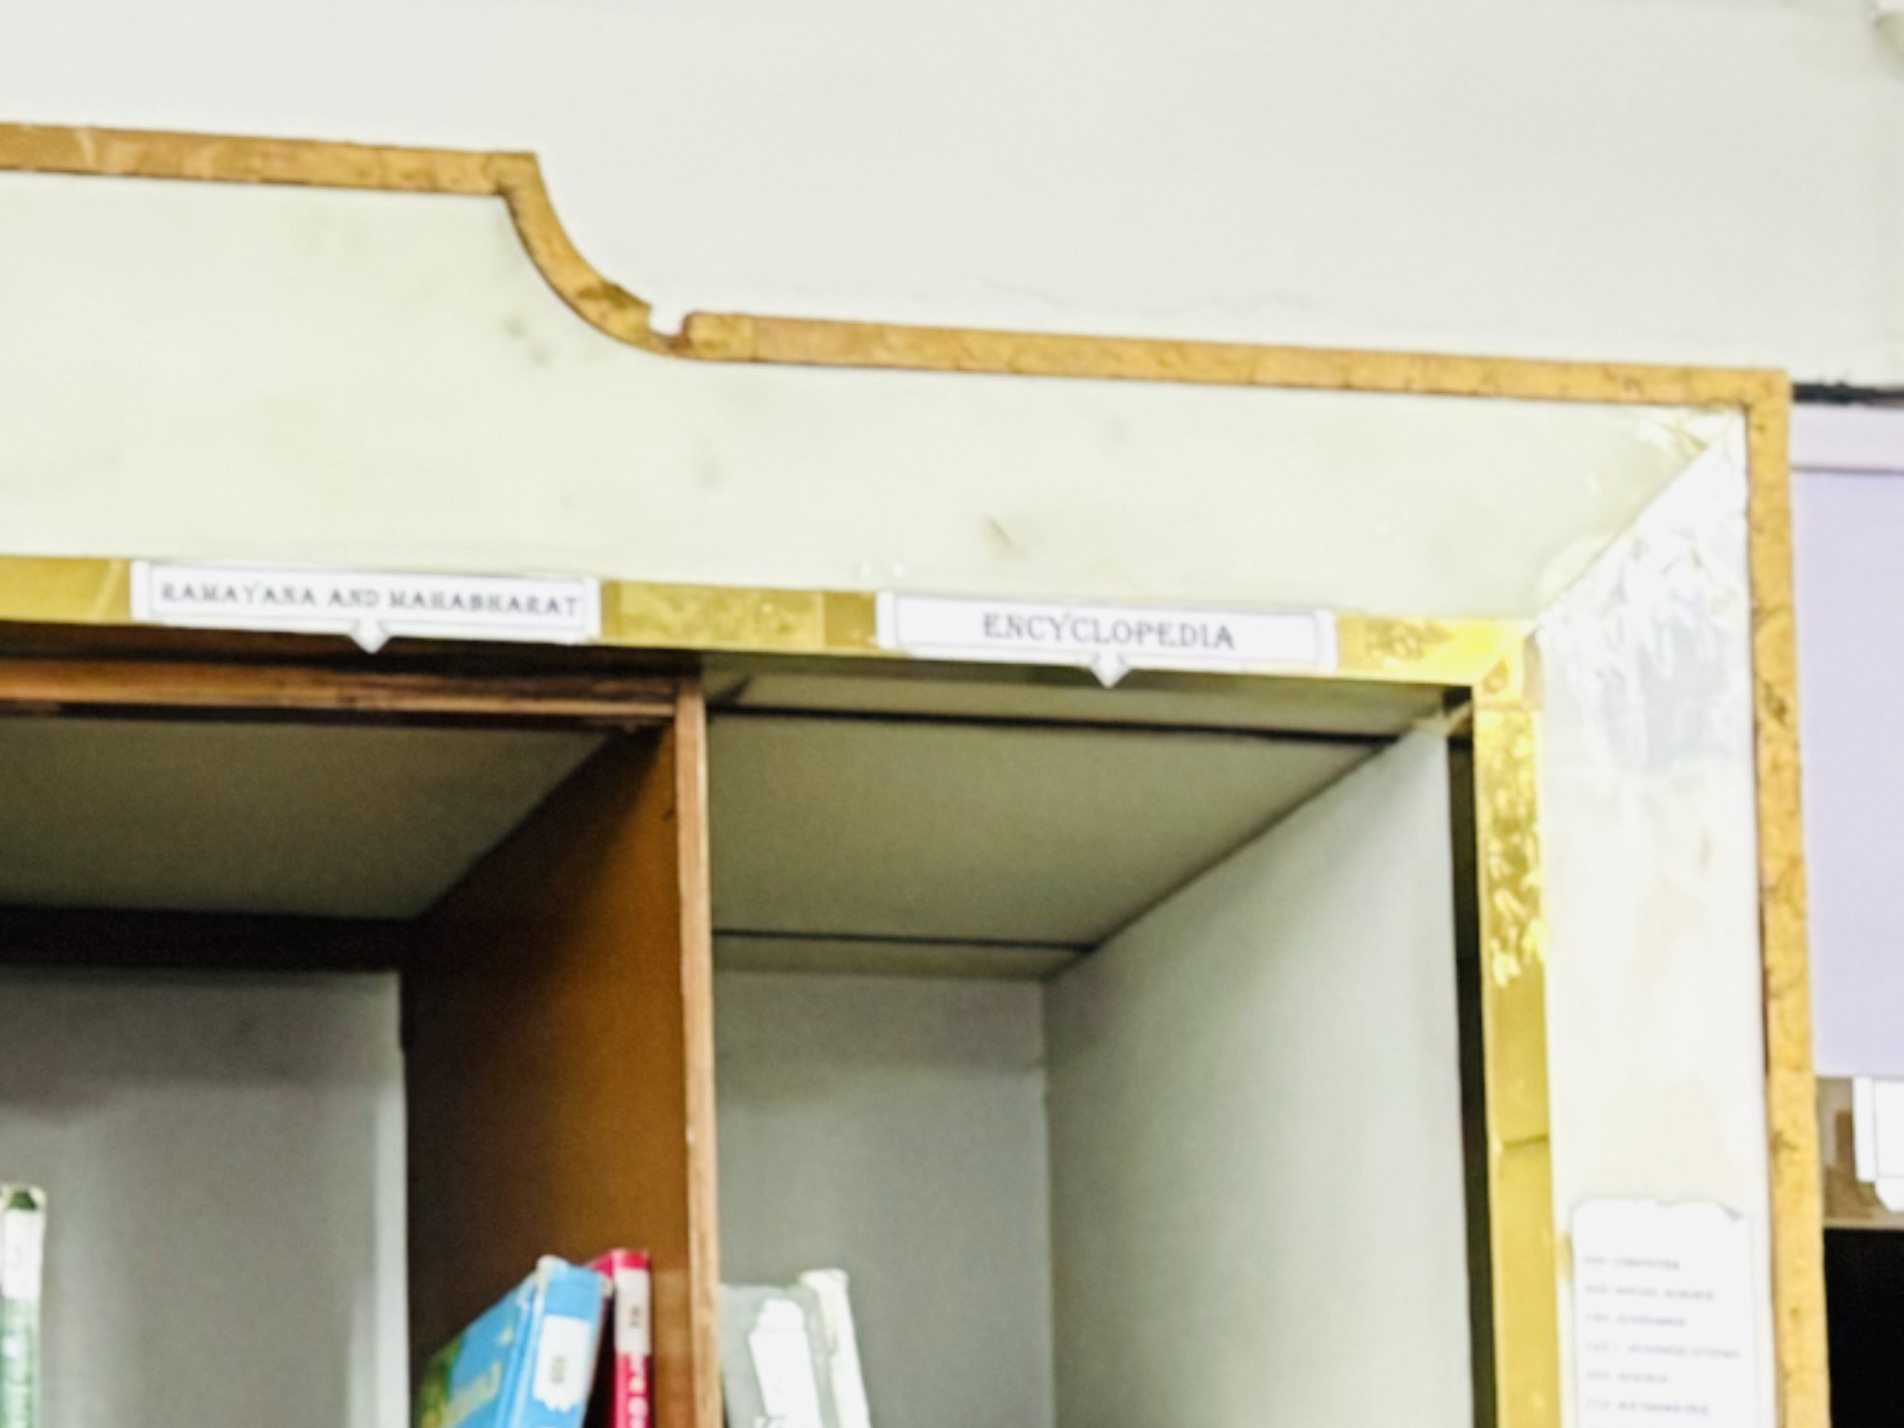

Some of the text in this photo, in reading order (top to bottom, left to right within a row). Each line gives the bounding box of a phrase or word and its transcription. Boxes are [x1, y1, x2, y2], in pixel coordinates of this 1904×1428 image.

[161, 581, 583, 620] RAMAYANA AND MAHABHARAT
[982, 611, 1235, 650] ENCYCLOPEDIA
